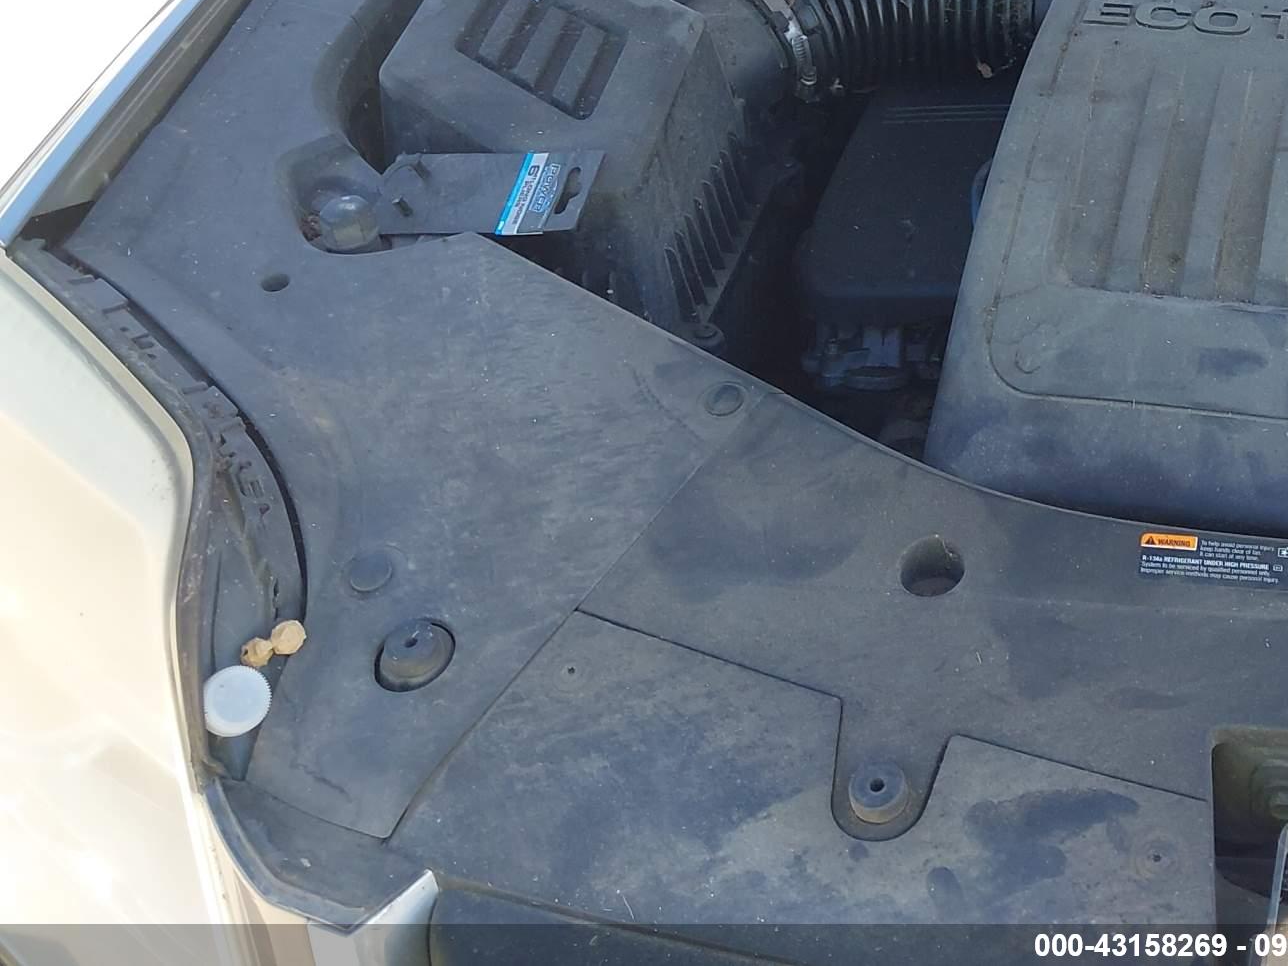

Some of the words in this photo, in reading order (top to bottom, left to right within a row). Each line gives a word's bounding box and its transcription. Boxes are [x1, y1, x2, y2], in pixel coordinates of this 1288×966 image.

[1158, 538, 1190, 547] WARNING
[1164, 556, 1202, 565] REFRIGERANT
[1240, 562, 1269, 570] PRESSURE
